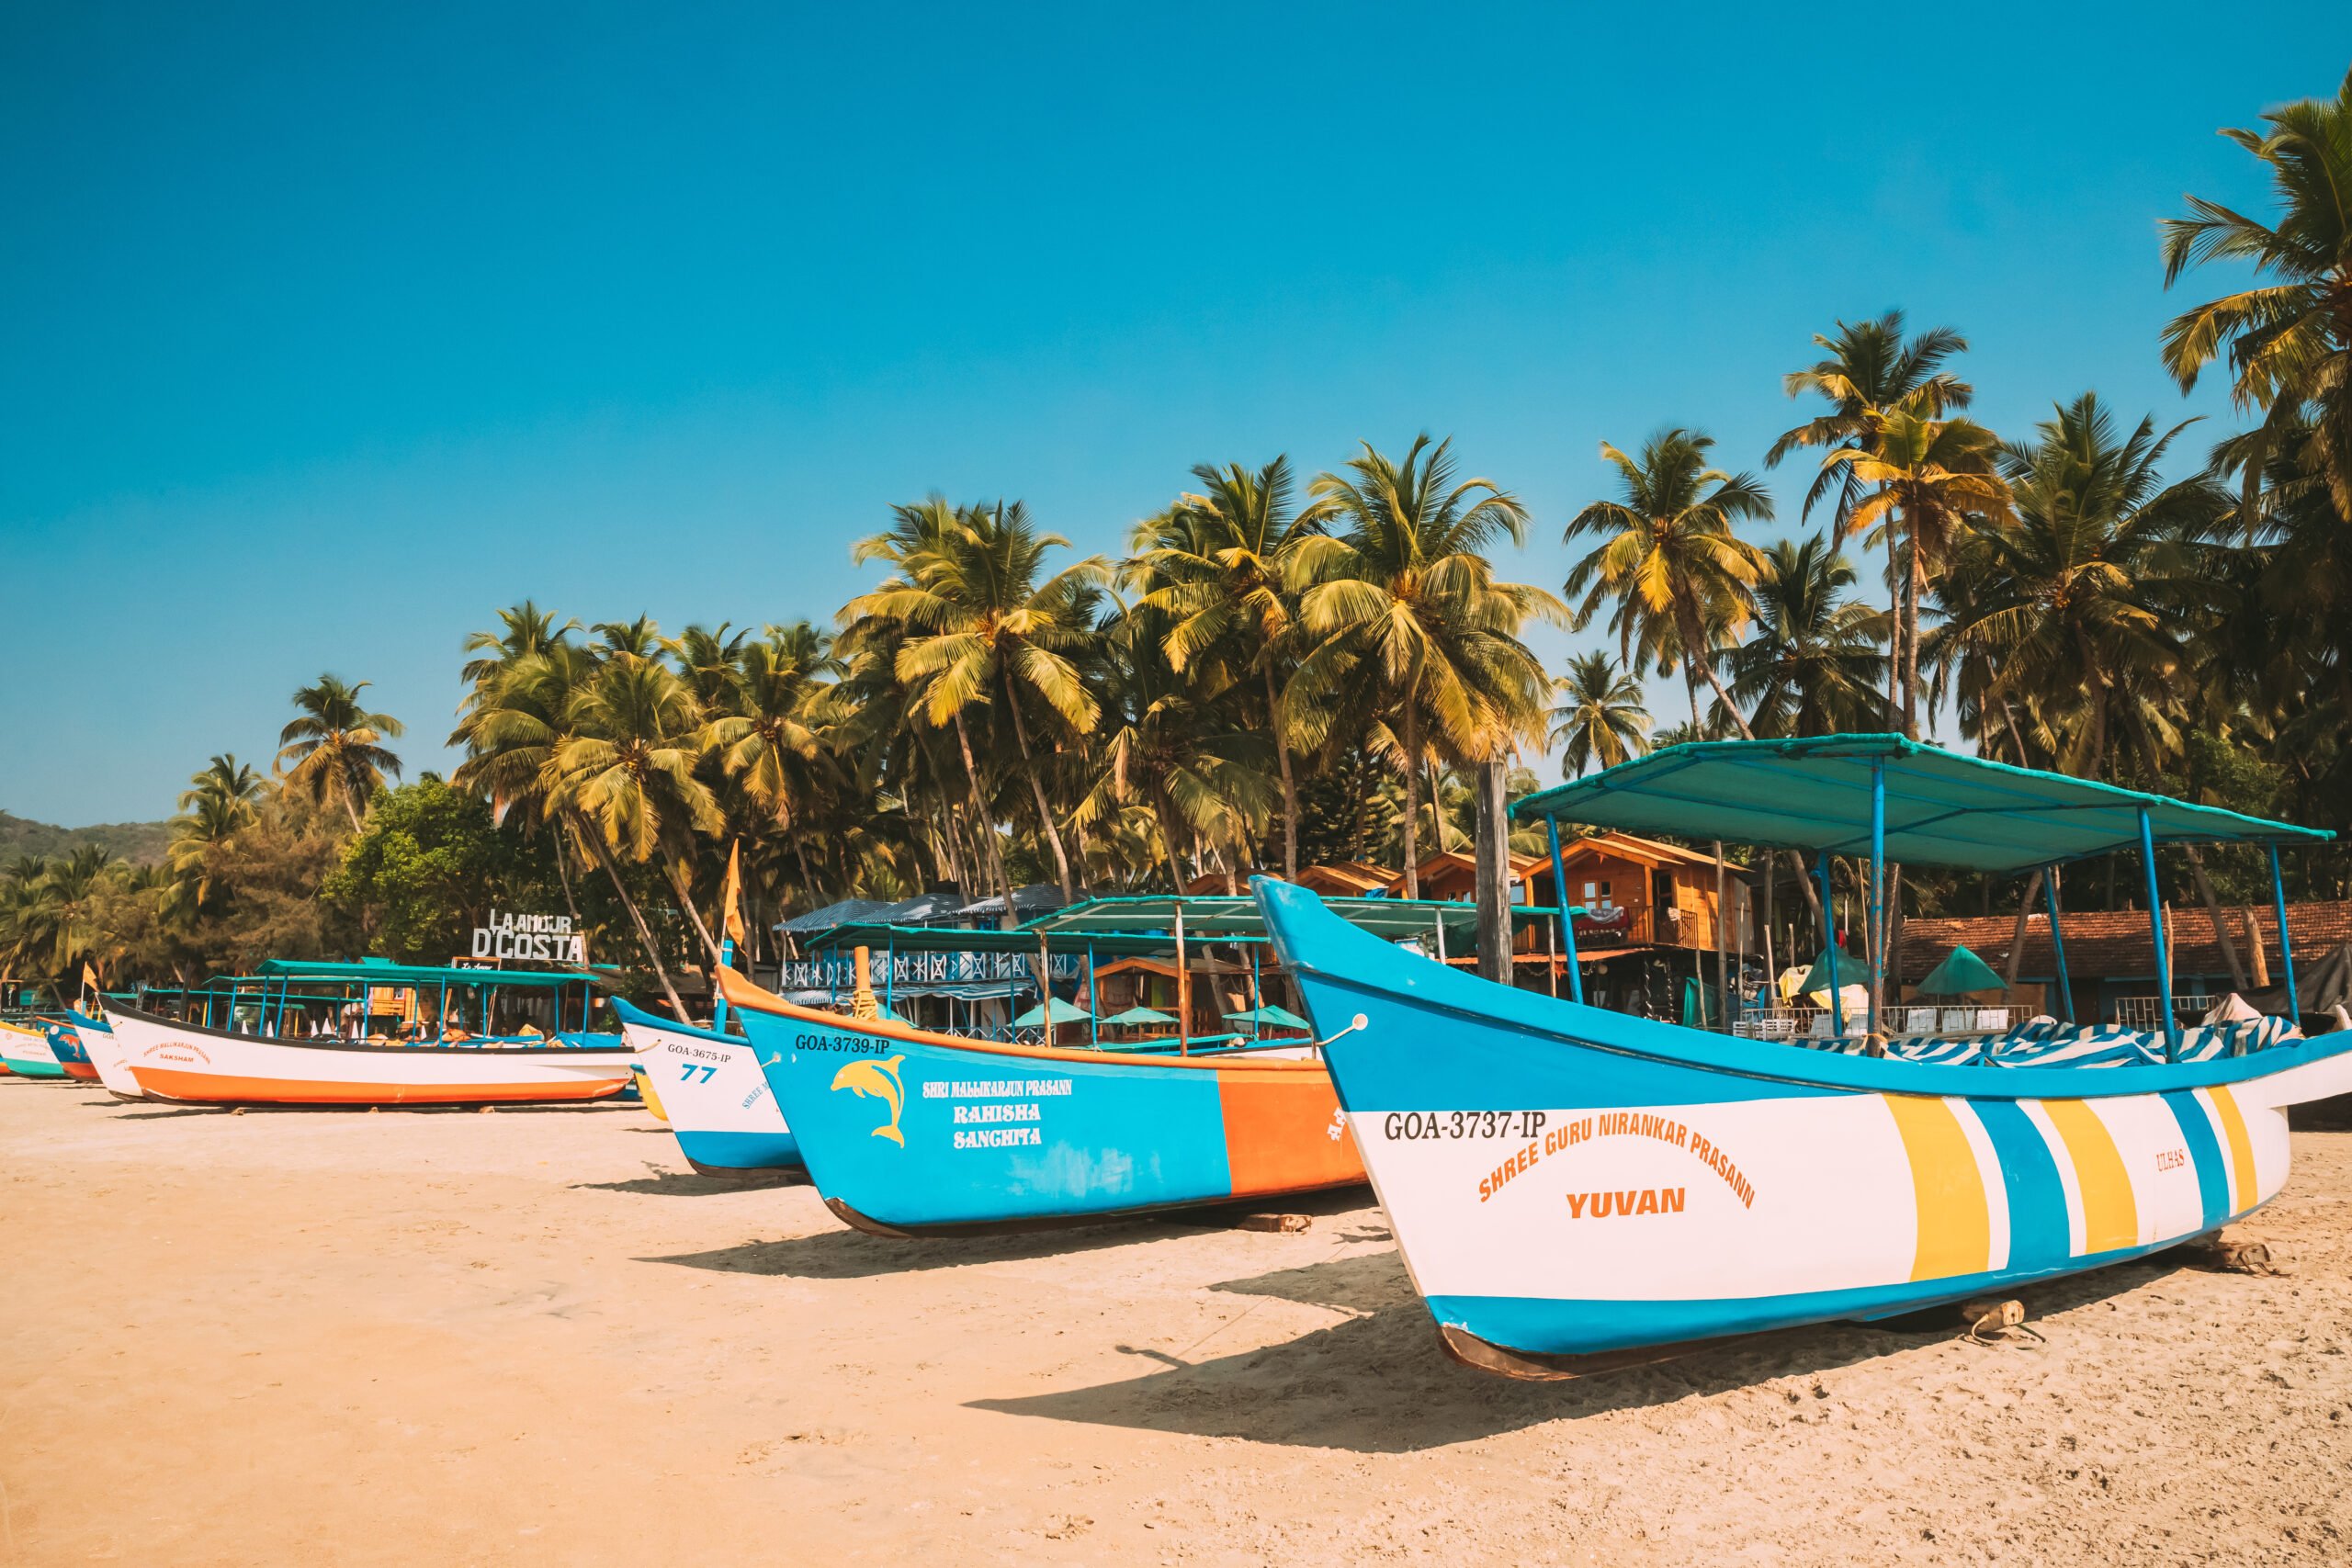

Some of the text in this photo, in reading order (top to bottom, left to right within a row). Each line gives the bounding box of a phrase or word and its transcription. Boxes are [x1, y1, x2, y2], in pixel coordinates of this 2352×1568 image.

[472, 928, 583, 962] D'COSTA
[667, 1043, 731, 1063] GOA-3675-IP
[796, 1034, 890, 1055] GOA-3739-IP
[160, 1054, 194, 1062] SAKSHAM
[680, 1063, 718, 1084] 77
[742, 1086, 763, 1110] SHREE
[922, 1081, 949, 1099] SHRI
[1025, 1079, 1073, 1097] PRASANN
[954, 1103, 1041, 1124] RAHISHA
[1385, 1111, 1546, 1141] GOA-3737-IP
[954, 1128, 1042, 1149] SANCHITA
[1479, 1112, 1756, 1210] SHREE GURU NIRANKAR PRASANN
[2156, 1148, 2185, 1172] ULHAS
[1566, 1187, 1685, 1219] YUVAN
